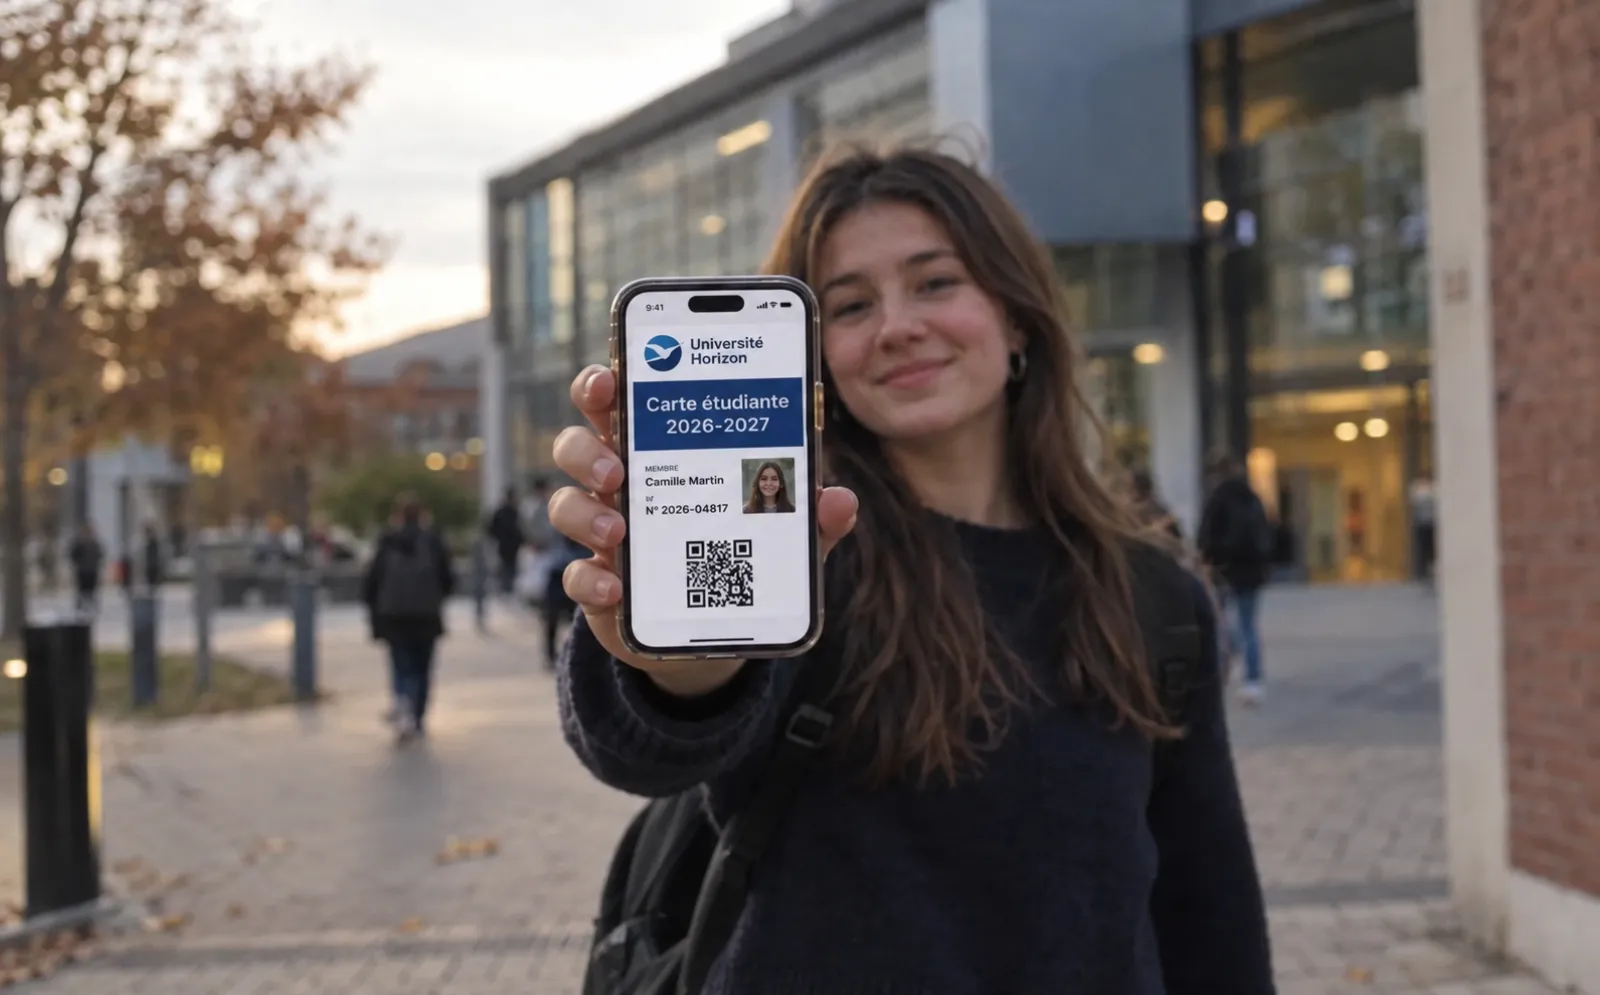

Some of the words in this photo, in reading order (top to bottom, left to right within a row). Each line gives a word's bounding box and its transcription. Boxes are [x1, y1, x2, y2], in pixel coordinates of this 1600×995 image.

[690, 336, 764, 350] Université
[691, 353, 748, 365] Horizon
[646, 397, 697, 412] Carte
[702, 394, 789, 410] étudiante
[666, 417, 769, 434] 2026-2027
[645, 477, 686, 486] Camille
[689, 476, 724, 485] Martin
[661, 503, 728, 515] 2026-04817
